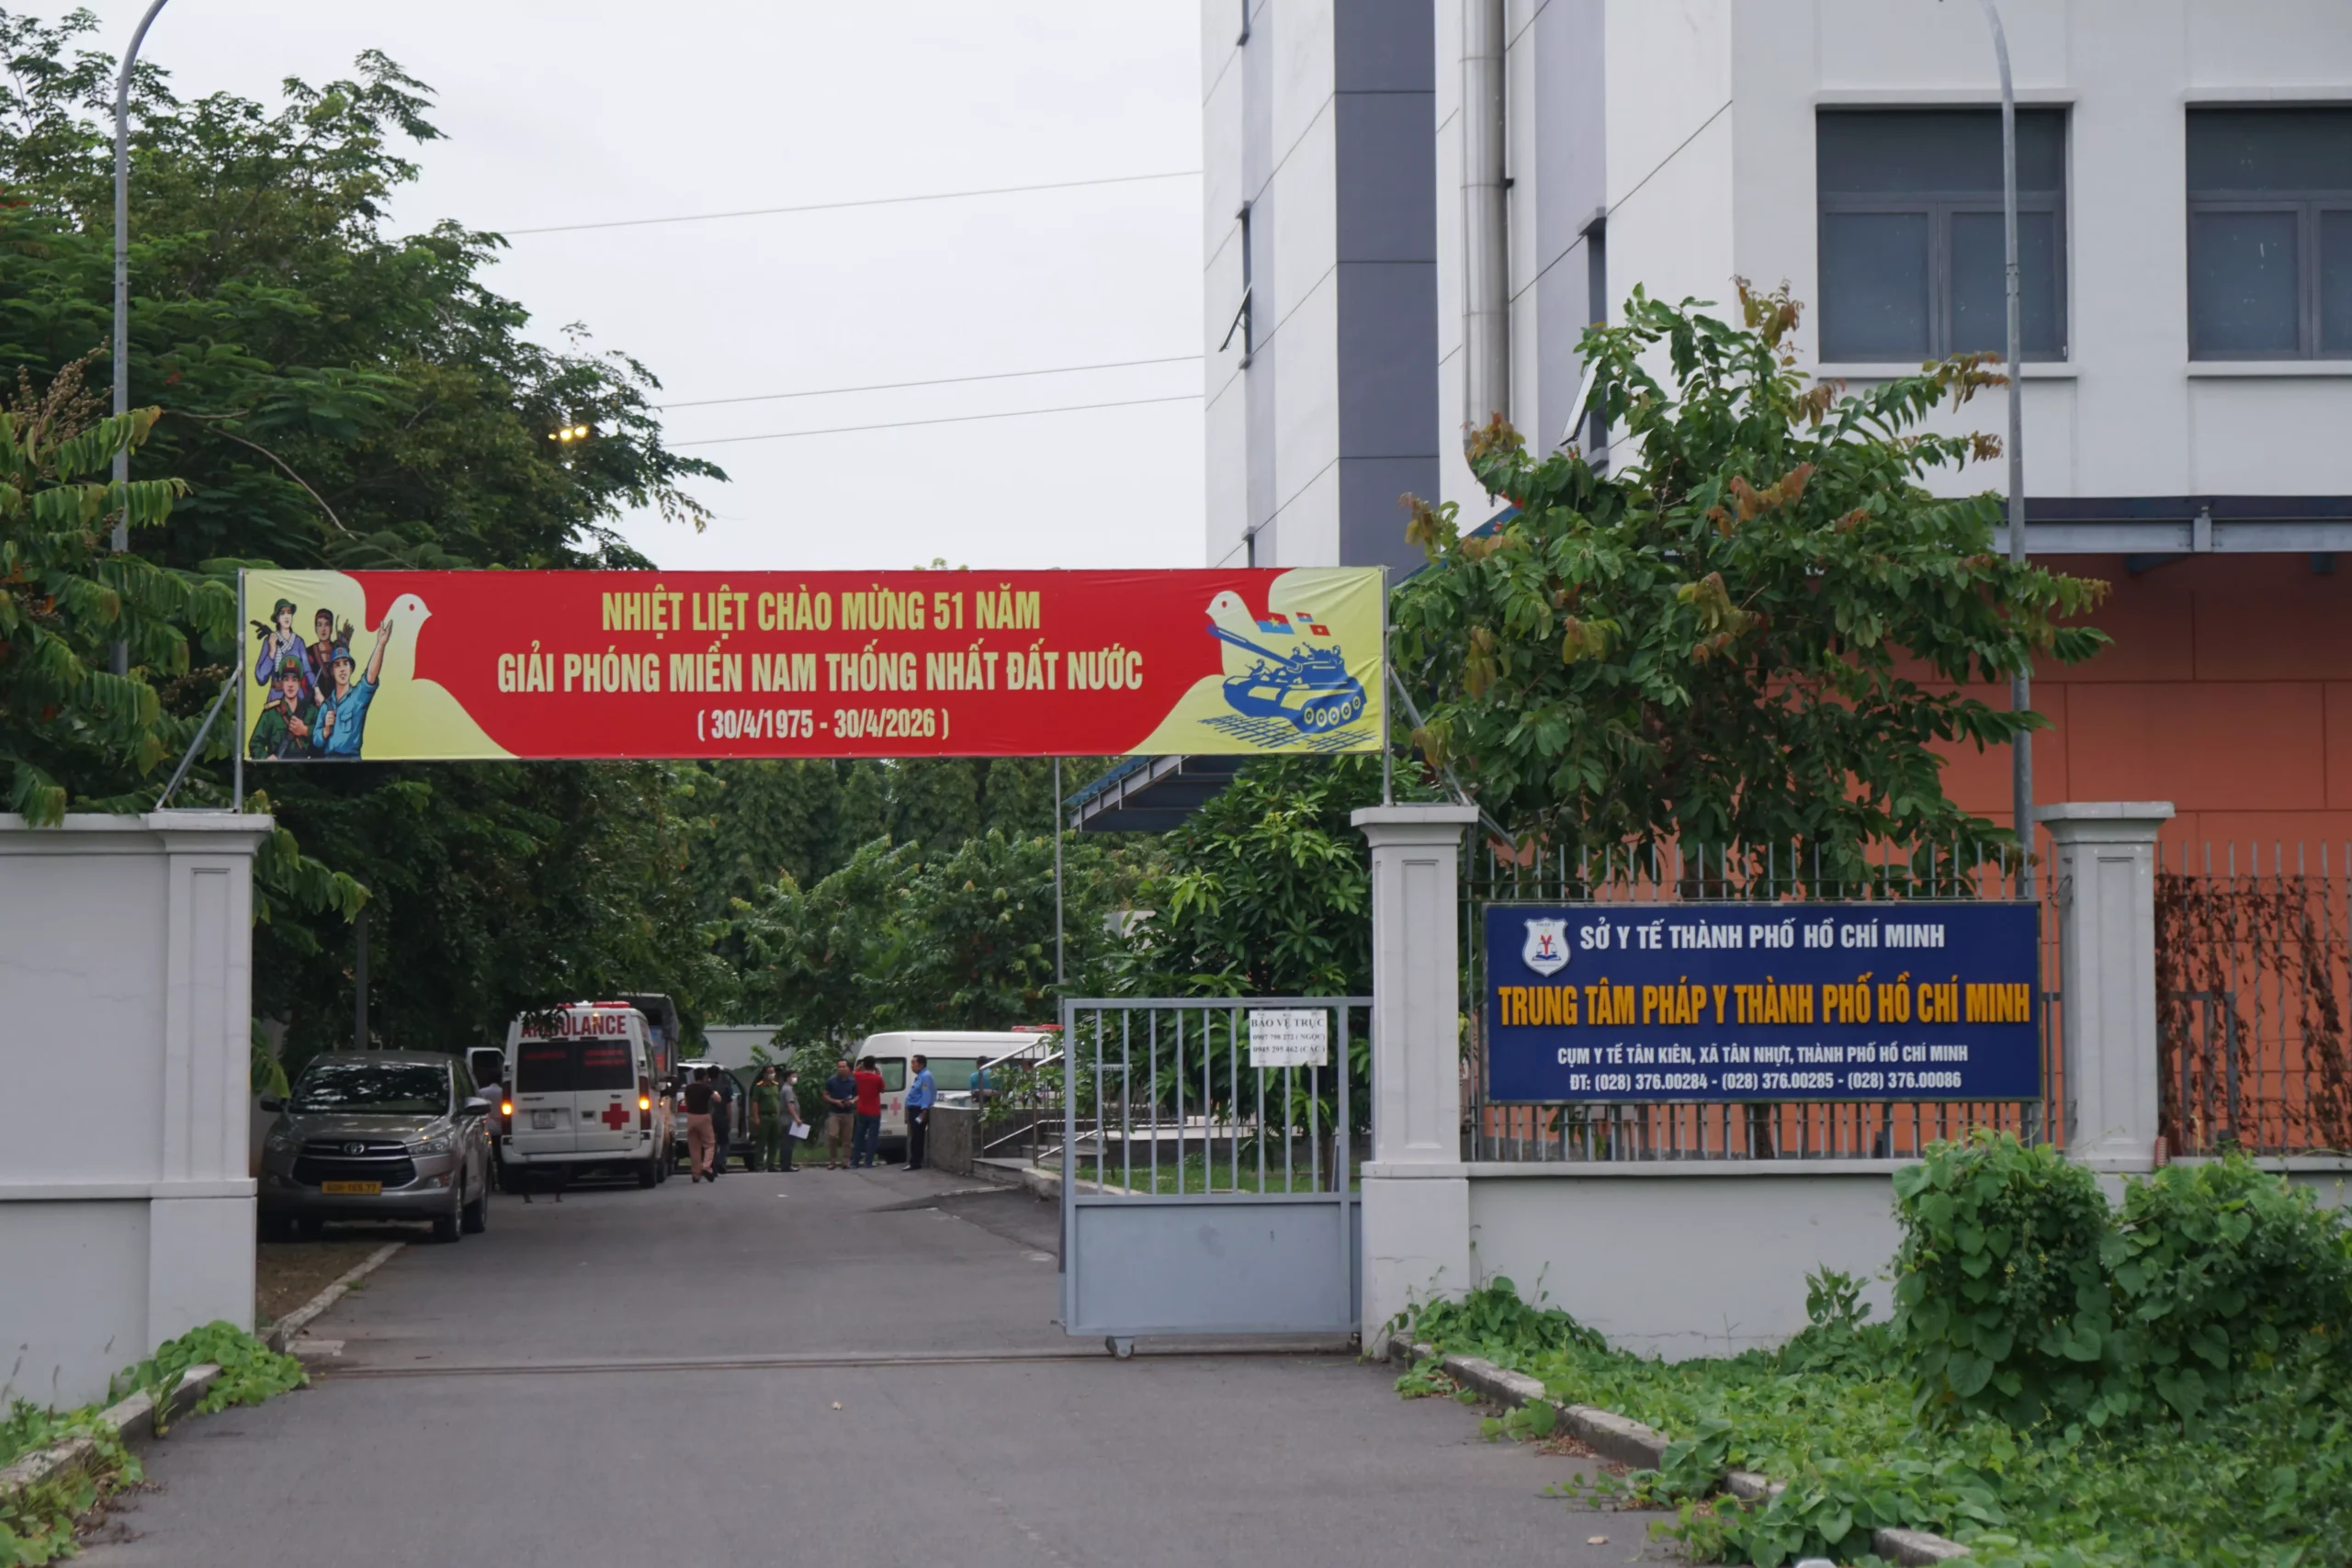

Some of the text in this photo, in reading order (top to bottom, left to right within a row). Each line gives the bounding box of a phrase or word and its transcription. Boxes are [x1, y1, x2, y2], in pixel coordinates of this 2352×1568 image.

[602, 582, 1045, 640] NHIỆT LIỆT CHÀO MỪNG 51 NĂM
[497, 637, 1143, 693] GIẢI PHÓNG MIỀN NAM THỐNG NHẤT ĐẤT NƯỚC
[711, 708, 814, 739] 30/4/1975
[833, 707, 935, 739] 30/4/2026
[1579, 916, 1945, 950] SỞ Y TẾ THÀNH PHỐ HỒ CHÍ MINH
[1498, 971, 2030, 1026] TRUNG TÂM PHÁP Y THÀNH PHỐ HỒ CHÍ MINH
[1251, 1017, 1325, 1030] BẢO VỆ TRỰC
[1557, 1047, 1590, 1067] CỤM
[1593, 1047, 1603, 1065] Y
[1606, 1043, 1623, 1065] TẾ
[1626, 1043, 1655, 1064] TÂN
[1657, 1043, 1696, 1066] KIÊN,
[1699, 1043, 1719, 1064] XÃ
[1723, 1043, 1750, 1064] TÂN
[1753, 1044, 1794, 1067] NHỰT,
[1797, 1043, 1844, 1063] THÀNH
[1847, 1041, 1876, 1063] PHỐ
[1902, 1042, 1927, 1063] CHÍ
[1929, 1044, 1968, 1062] MINH
[1569, 1073, 1591, 1090] ĐT:
[1594, 1073, 1632, 1092] (028)
[1634, 1073, 1709, 1090] 376.00284
[1722, 1072, 1758, 1091] (028)
[1761, 1072, 1834, 1089] 376.00285
[1848, 1071, 1884, 1090] (028)
[1887, 1071, 1962, 1089] 376.00086
